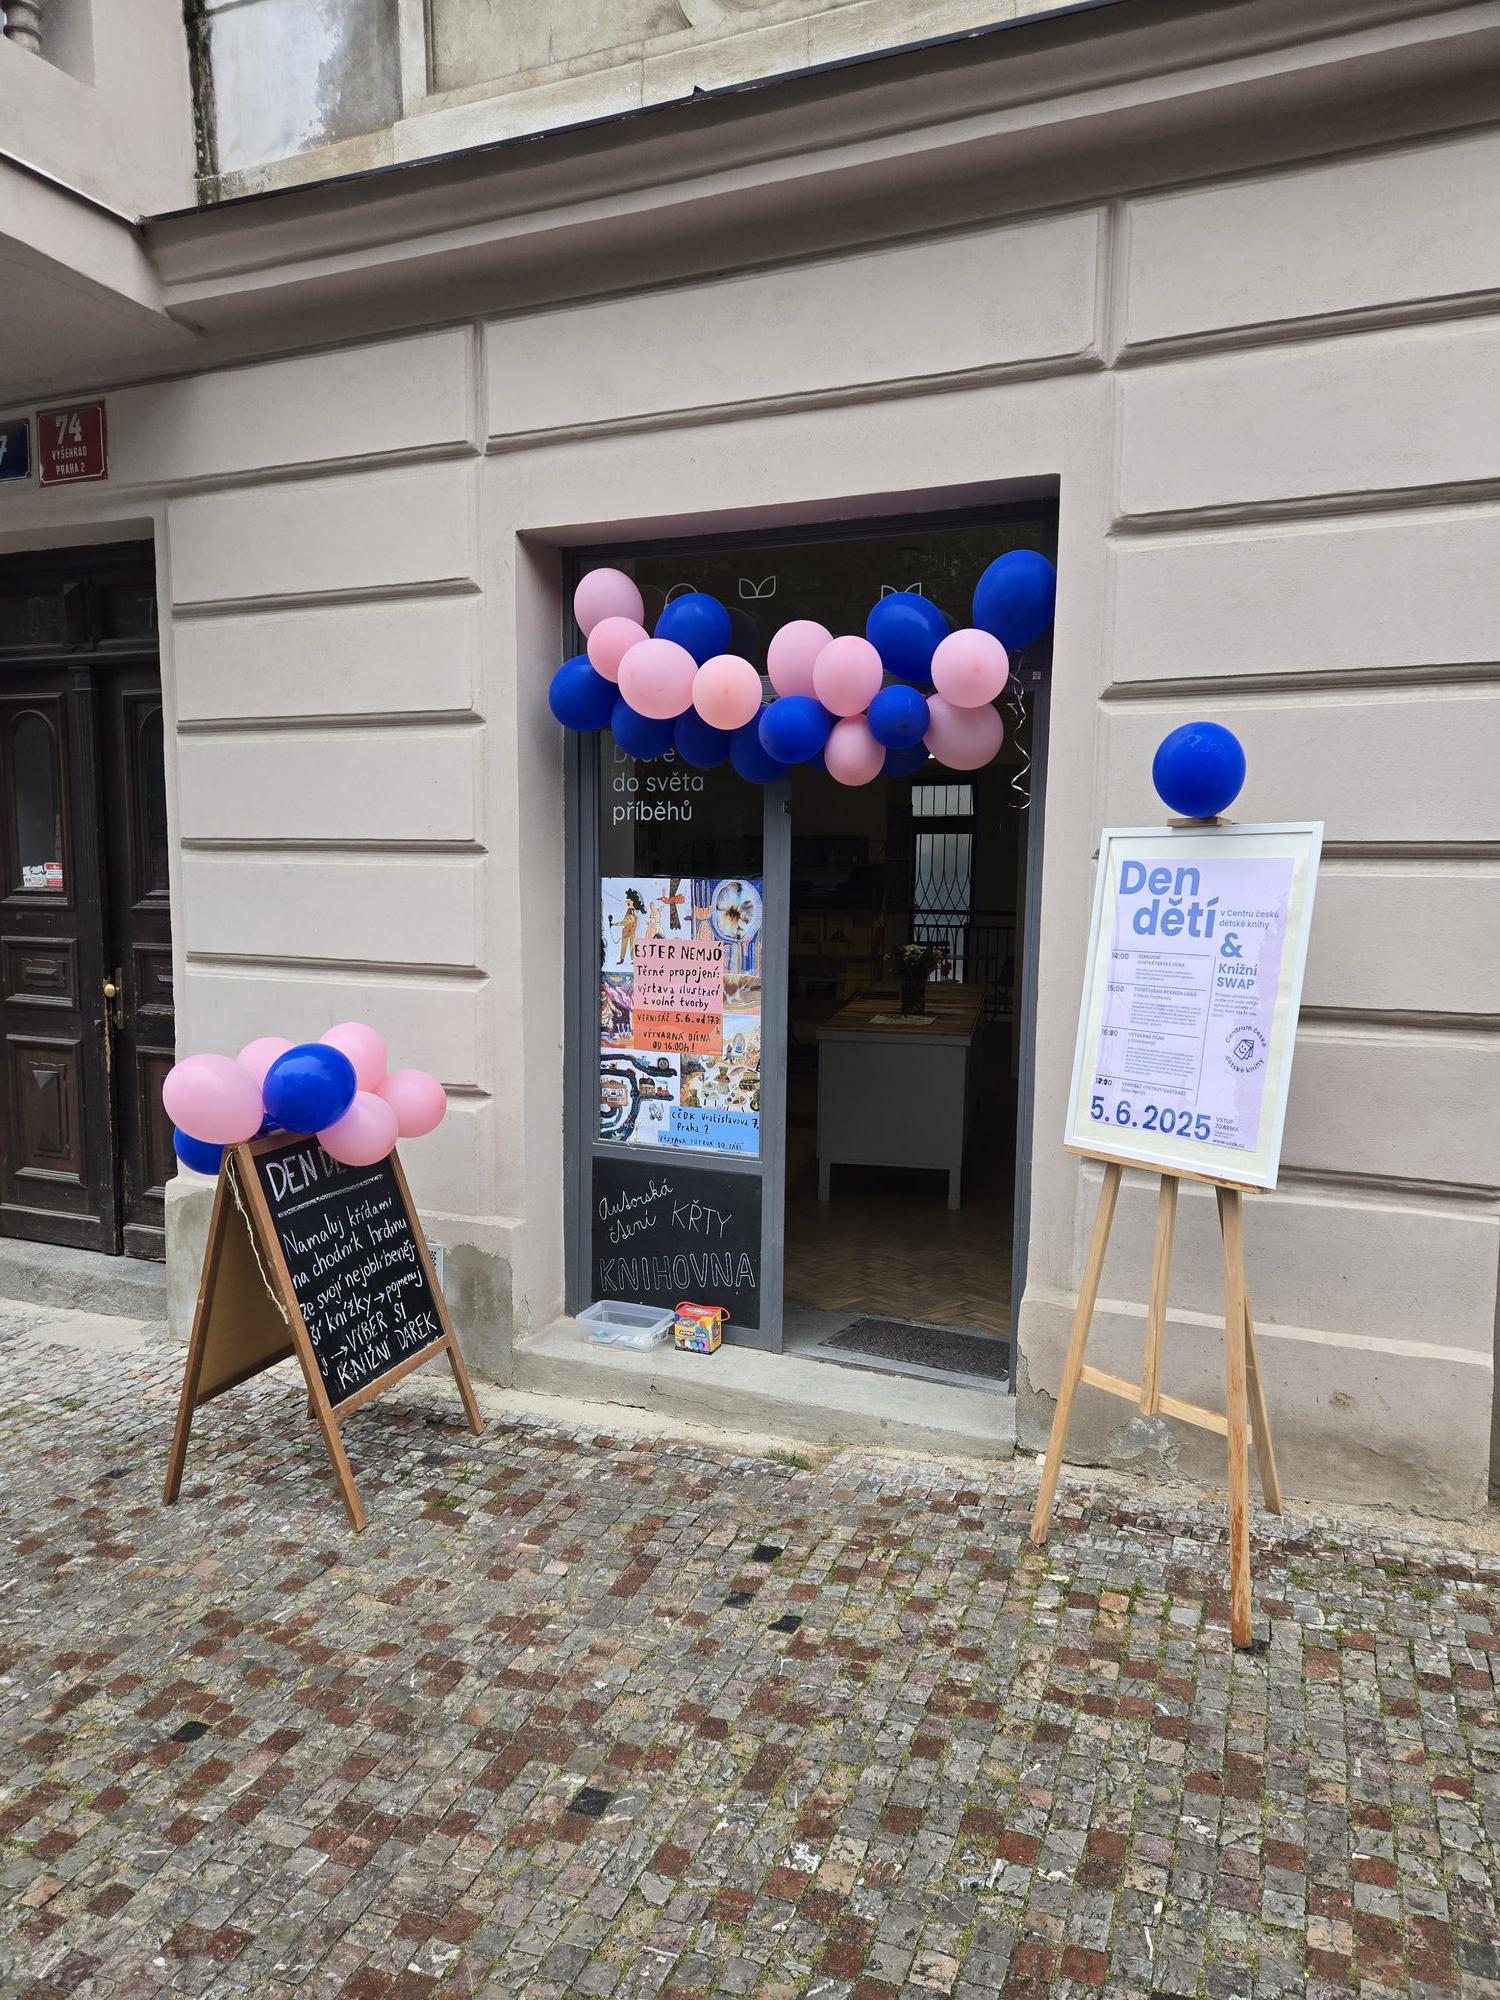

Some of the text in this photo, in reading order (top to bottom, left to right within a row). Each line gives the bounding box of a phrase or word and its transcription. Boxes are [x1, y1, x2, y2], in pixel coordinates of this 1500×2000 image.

[55, 413, 82, 445] 74
[51, 446, 88, 461] VYŠEHRAD
[56, 463, 85, 475] PRAHA 2
[613, 772, 704, 792] do světa
[613, 800, 692, 826] příběhů
[1118, 860, 1201, 896] Den
[1132, 895, 1220, 939] dětí
[1226, 910, 1254, 918] Centru
[1219, 919, 1270, 930] dětské knihy
[634, 942, 723, 962] ESTER NEMJÓ
[1220, 932, 1243, 958] &
[1111, 952, 1129, 960] 14:00
[636, 965, 720, 984] Těsné propojení:
[1218, 963, 1258, 977] Knižní
[637, 983, 721, 996] výstava ilustrací
[1107, 984, 1125, 992] 15:00
[1216, 977, 1255, 990] SWAP
[643, 996, 710, 1011] a volné tvorby
[696, 1014, 706, 1024] od
[1225, 1025, 1253, 1043] Centrum
[652, 1041, 662, 1050] OD
[671, 1108, 695, 1120] CČDK
[701, 1113, 748, 1127] Vratislavova
[677, 1123, 709, 1134] Praha 2
[265, 1149, 318, 1203] DEN
[598, 1177, 674, 1221] Autorská
[283, 1191, 393, 1262] Namaluj křídami
[609, 1210, 656, 1244] čtení
[672, 1200, 733, 1239] KŘTY
[292, 1217, 407, 1290] na chodník hrdinu
[599, 1252, 756, 1292] KNIHOVNA
[299, 1301, 316, 1322] ze
[317, 1273, 343, 1309] svojí
[310, 1265, 423, 1346] ší knížky pojmenuj
[393, 1301, 407, 1323] SI
[336, 1333, 391, 1390] KNIŽNÍ
